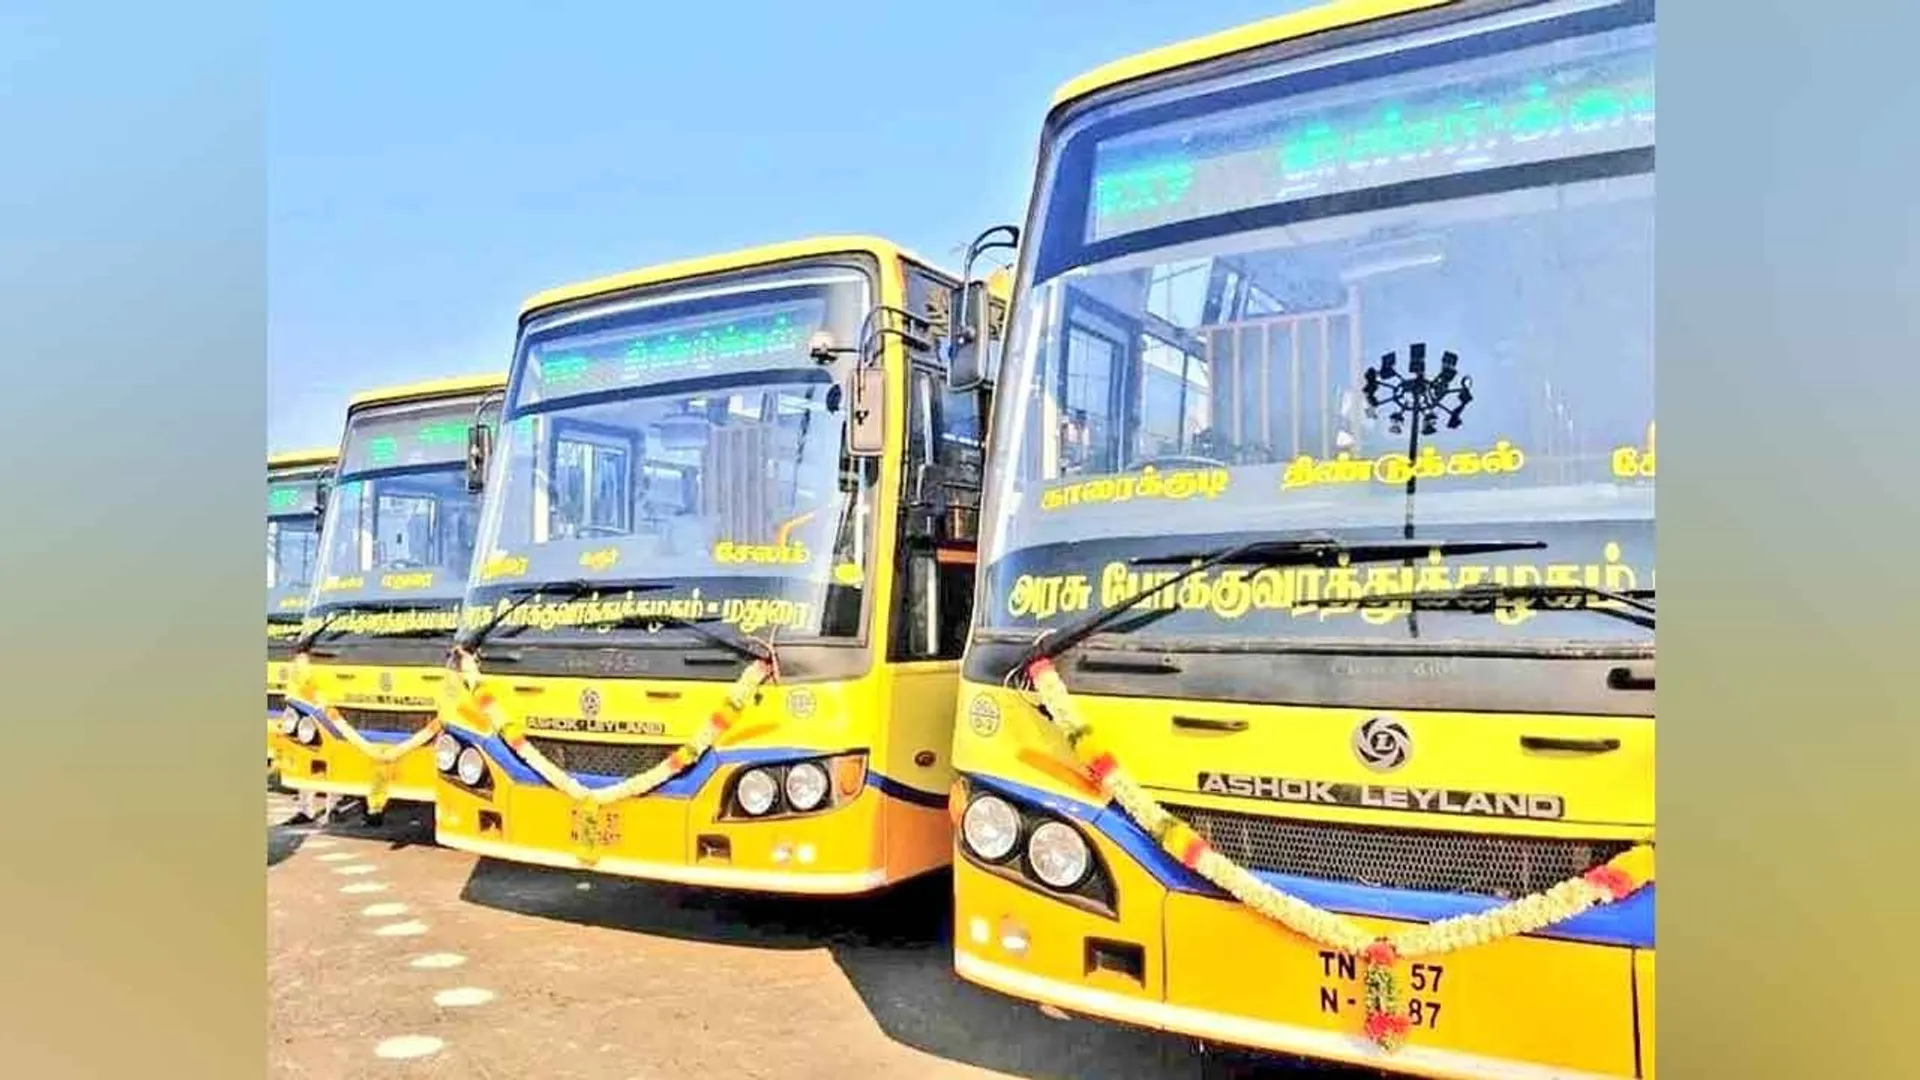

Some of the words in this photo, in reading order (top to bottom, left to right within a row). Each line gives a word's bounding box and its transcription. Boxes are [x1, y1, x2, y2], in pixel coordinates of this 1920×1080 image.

[1041, 465, 1229, 509] காரைக்குடி
[1282, 440, 1524, 491] திண்டுக்கல்
[1008, 574, 1092, 619] அரசு
[1201, 773, 1338, 802] ASHOK
[1361, 785, 1562, 818] LEYLAND
[1319, 951, 1356, 980] TN
[1411, 964, 1443, 992] 57
